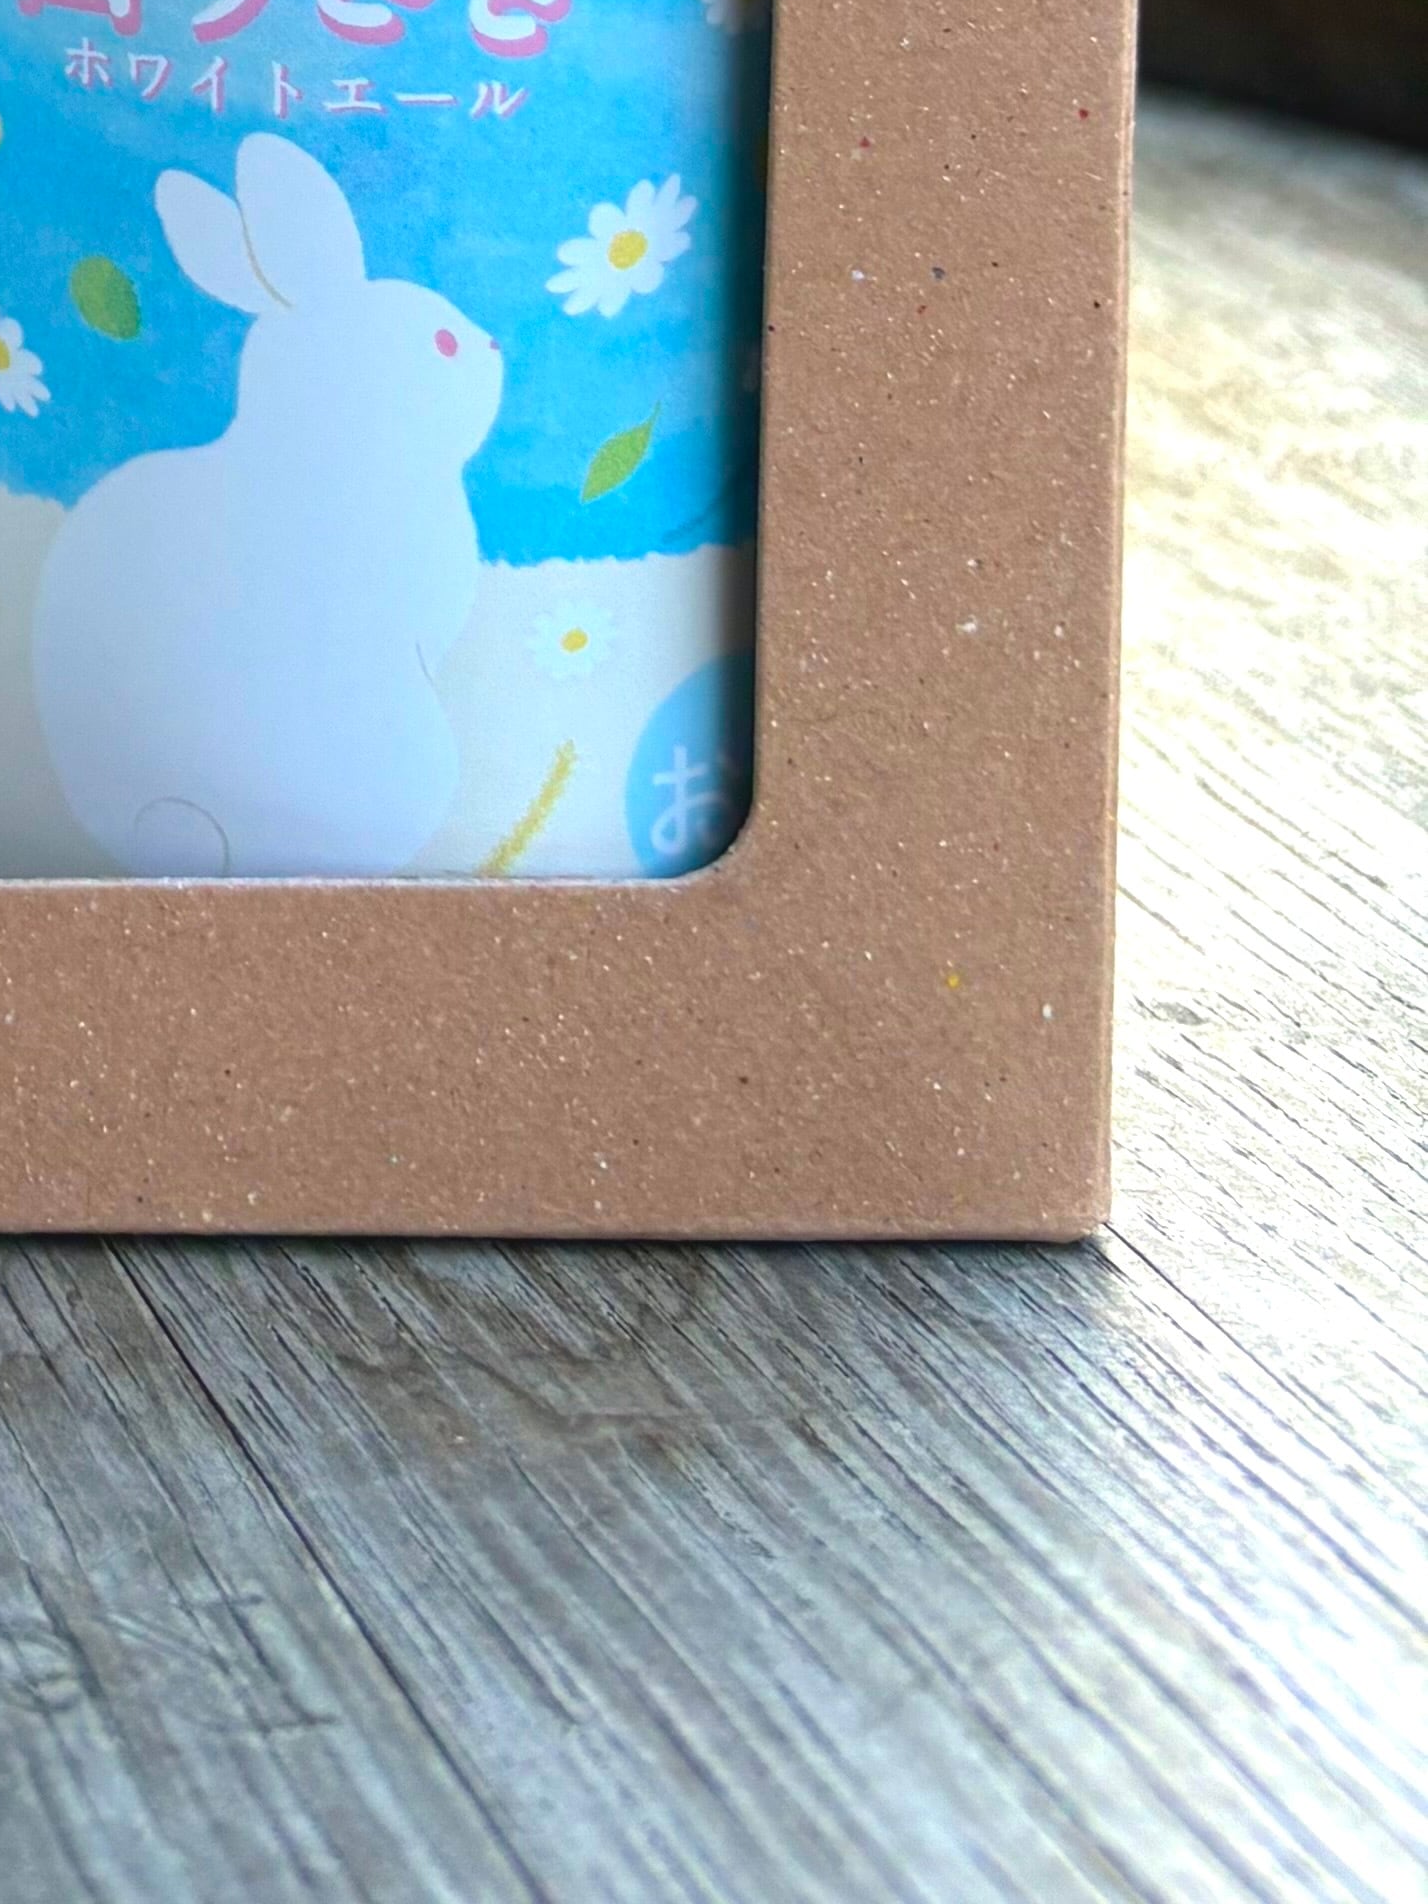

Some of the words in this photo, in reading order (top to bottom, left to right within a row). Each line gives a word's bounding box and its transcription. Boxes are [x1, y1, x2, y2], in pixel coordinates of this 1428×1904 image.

[64, 37, 530, 119] ホワイトエール
